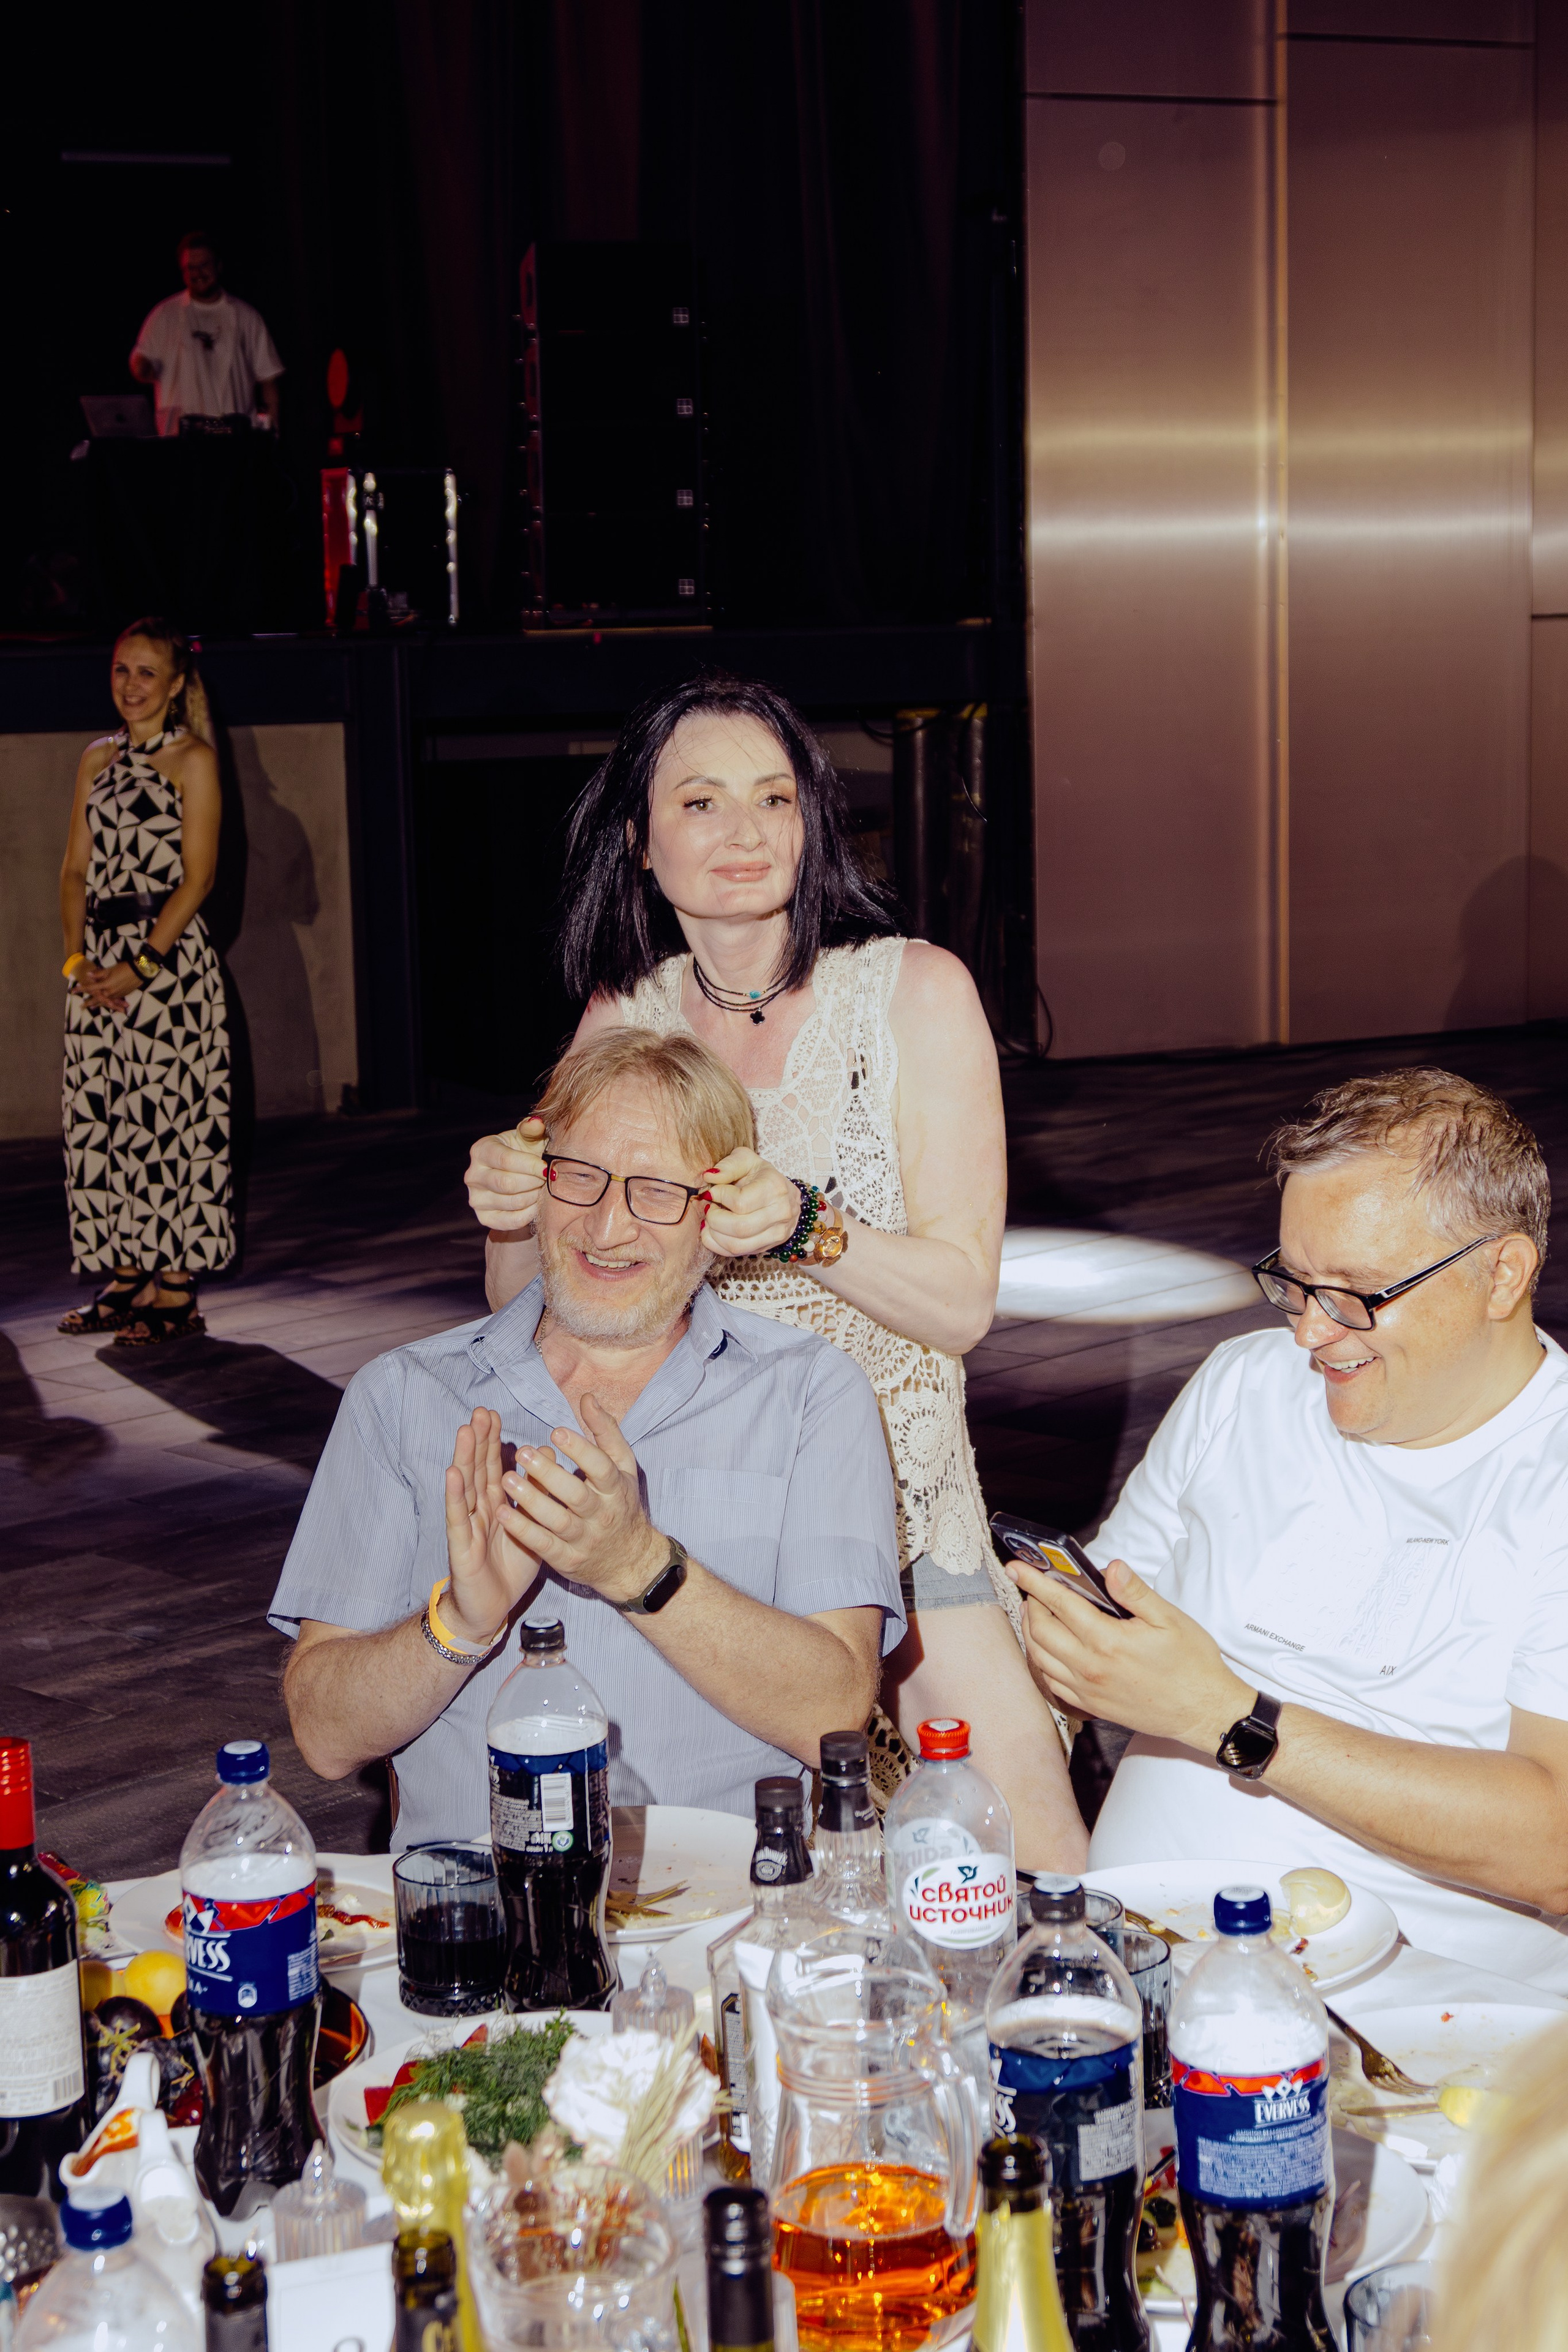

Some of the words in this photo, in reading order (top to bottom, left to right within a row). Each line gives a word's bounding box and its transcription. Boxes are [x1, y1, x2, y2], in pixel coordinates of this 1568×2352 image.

[1245, 1623, 1270, 1637] ARMANI
[1269, 1632, 1305, 1651] EXCHANGE
[185, 1934, 230, 1972] VESS
[1256, 2096, 1310, 2124] EVERVESS
